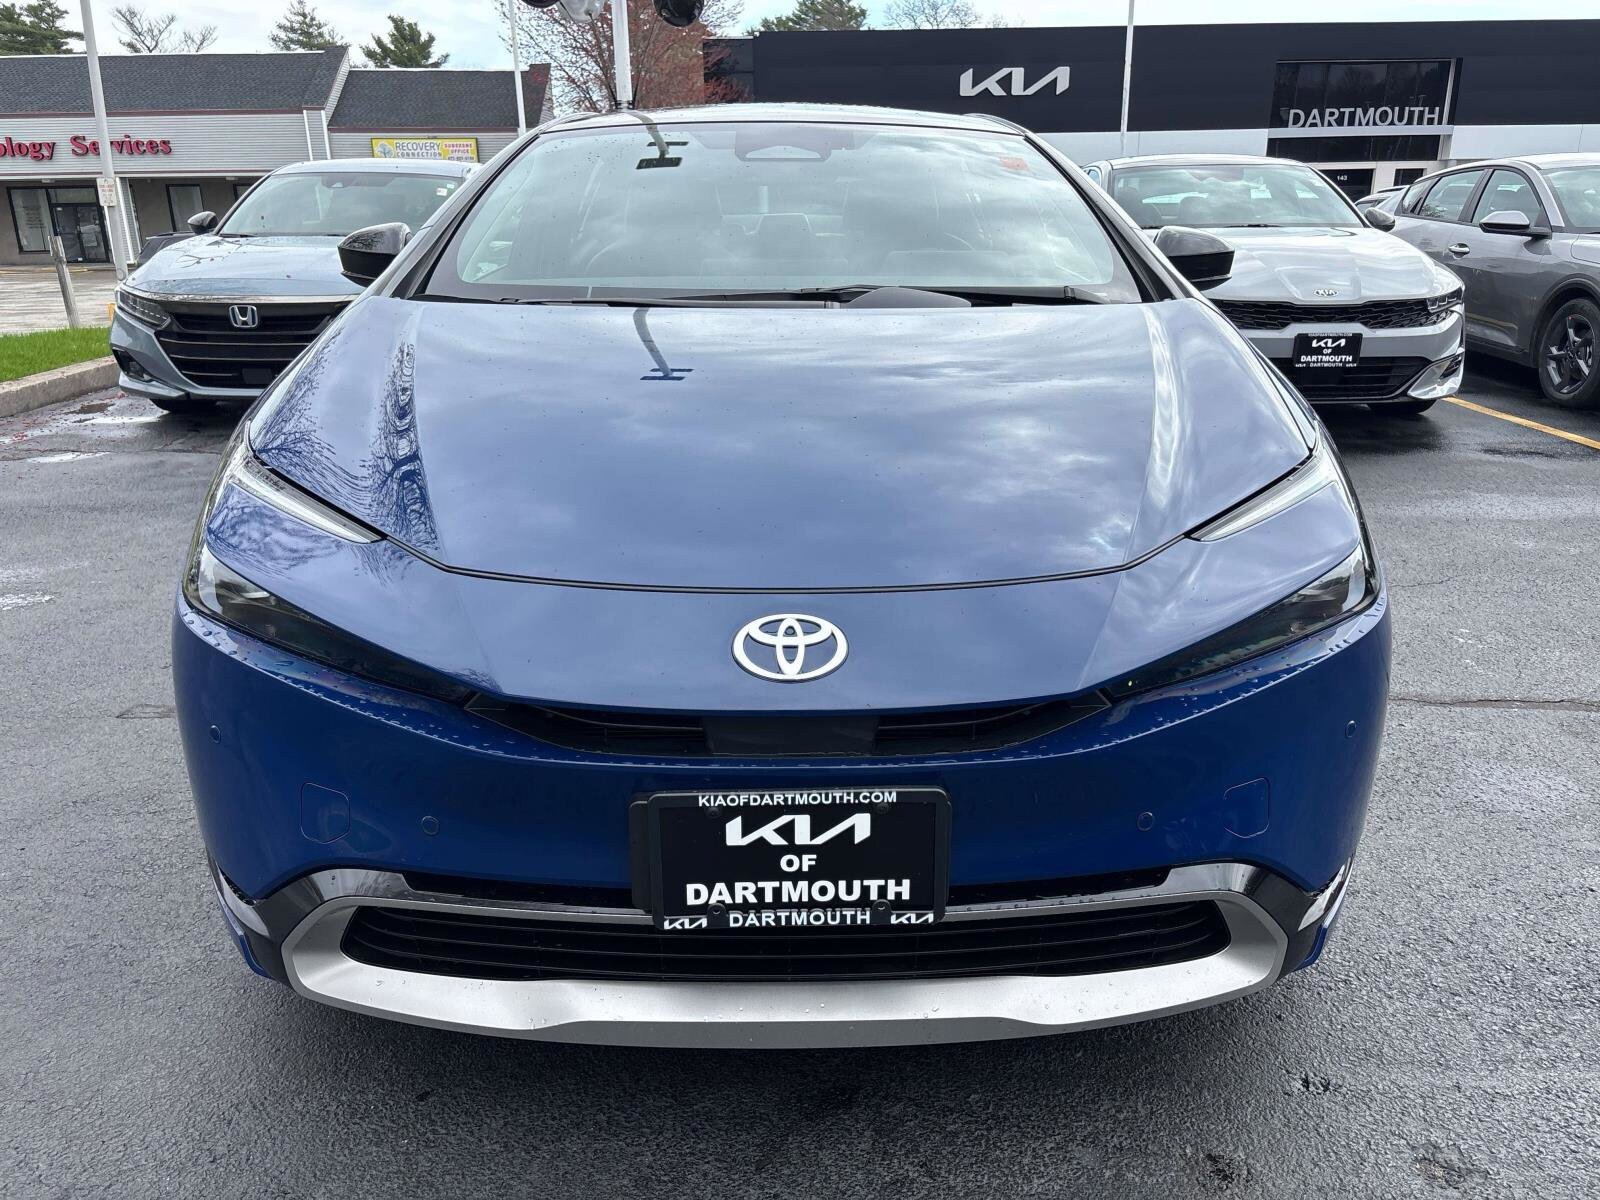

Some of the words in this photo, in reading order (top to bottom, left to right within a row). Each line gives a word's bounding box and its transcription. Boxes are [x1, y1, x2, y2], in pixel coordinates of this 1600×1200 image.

[959, 66, 1070, 97] KIA
[1288, 106, 1441, 129] DARTMOUTH
[70, 134, 172, 157] Sevices
[395, 142, 441, 151] RECOVERY
[1312, 338, 1346, 347] KIA
[698, 791, 898, 807] KIAOFDARTMOUTH.COM
[725, 812, 871, 846] KIA
[779, 853, 818, 873] OF
[685, 878, 911, 906] DARTMOUTH
[663, 917, 708, 930] KIA
[728, 910, 872, 928] DARTMOUTH
[889, 912, 935, 925] KIA
